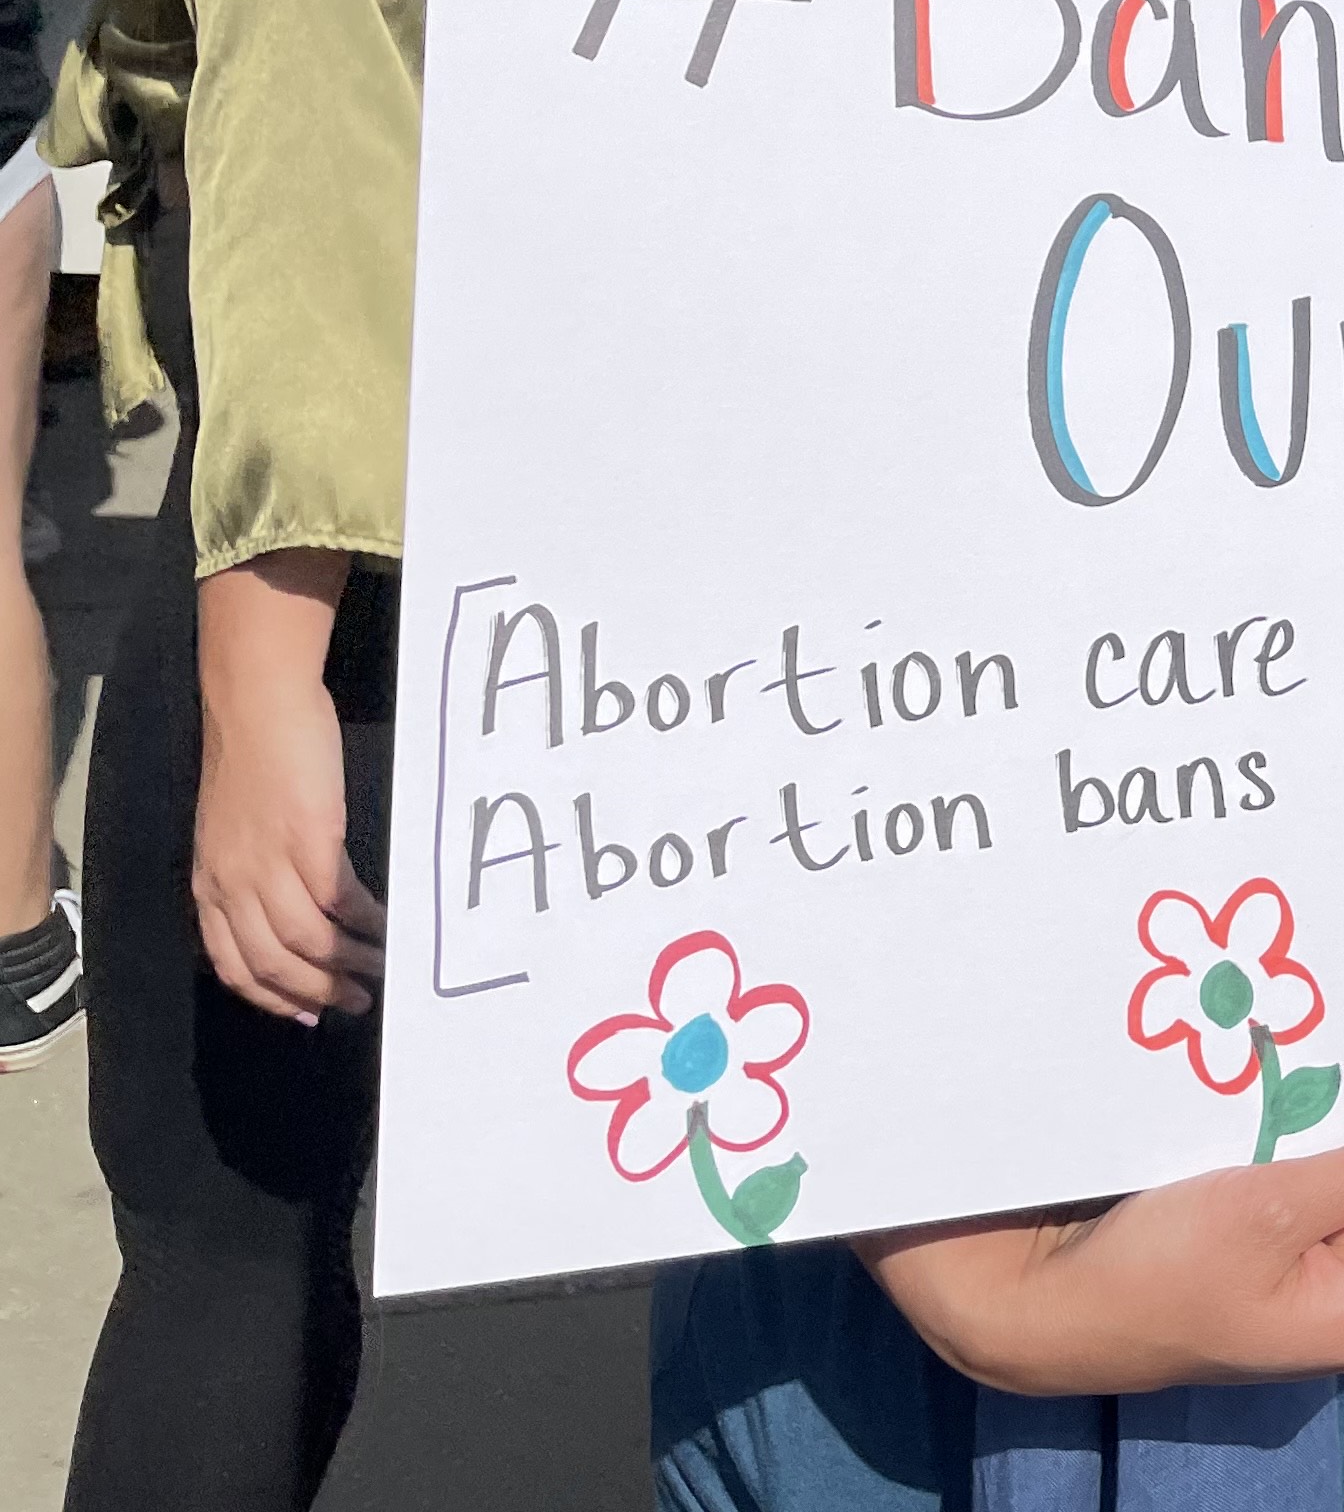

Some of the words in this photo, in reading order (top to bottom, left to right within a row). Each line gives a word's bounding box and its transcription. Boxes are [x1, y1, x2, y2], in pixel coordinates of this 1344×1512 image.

[480, 602, 1019, 750] Abortion
[1085, 613, 1308, 710] care
[467, 790, 993, 914] Abortion
[1054, 747, 1276, 834] bans
